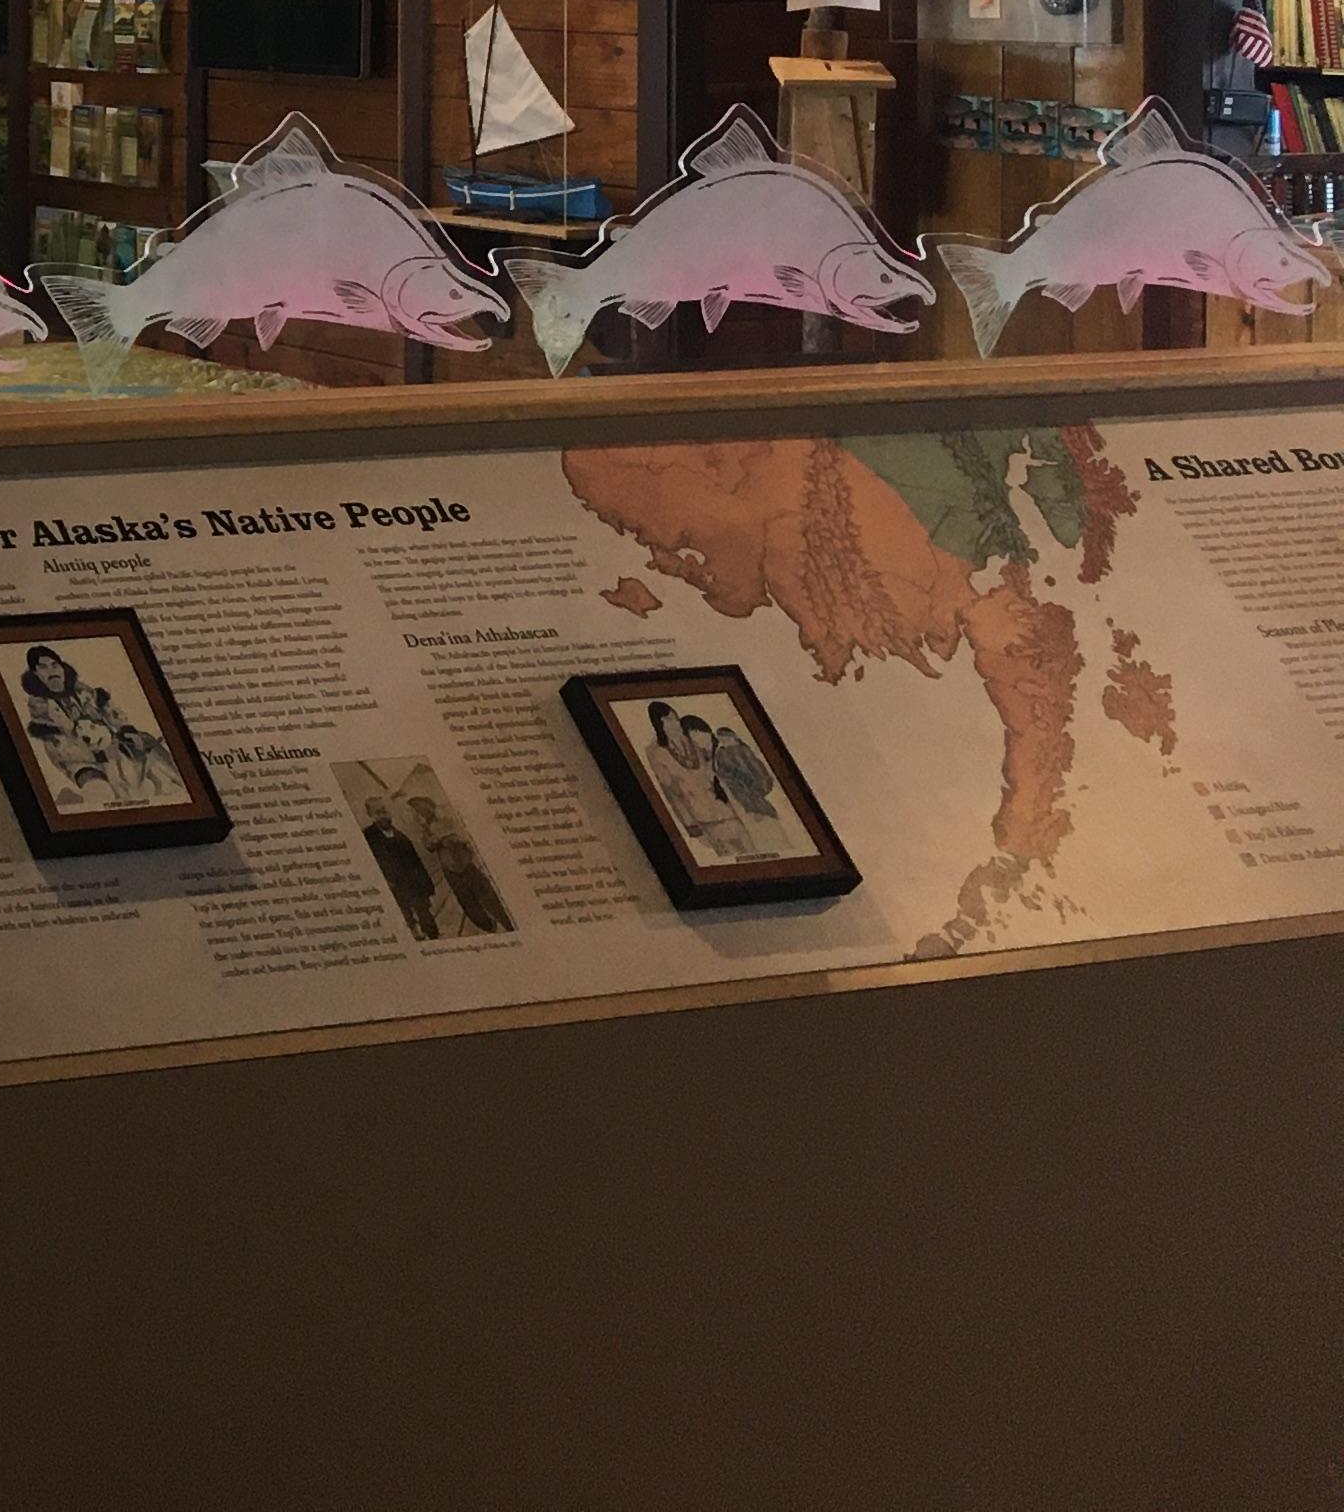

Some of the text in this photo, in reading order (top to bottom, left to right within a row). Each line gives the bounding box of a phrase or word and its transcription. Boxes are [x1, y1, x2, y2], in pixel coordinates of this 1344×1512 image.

[1144, 458, 1174, 482] A
[1171, 450, 1293, 480] Shared
[32, 512, 199, 549] Alaska's
[201, 506, 336, 538] Native
[339, 497, 472, 532] People
[43, 554, 152, 575] Alutiiq people
[403, 626, 560, 649] Dena'ina Athabascan
[200, 745, 321, 769] Yup'ik Eskimos
